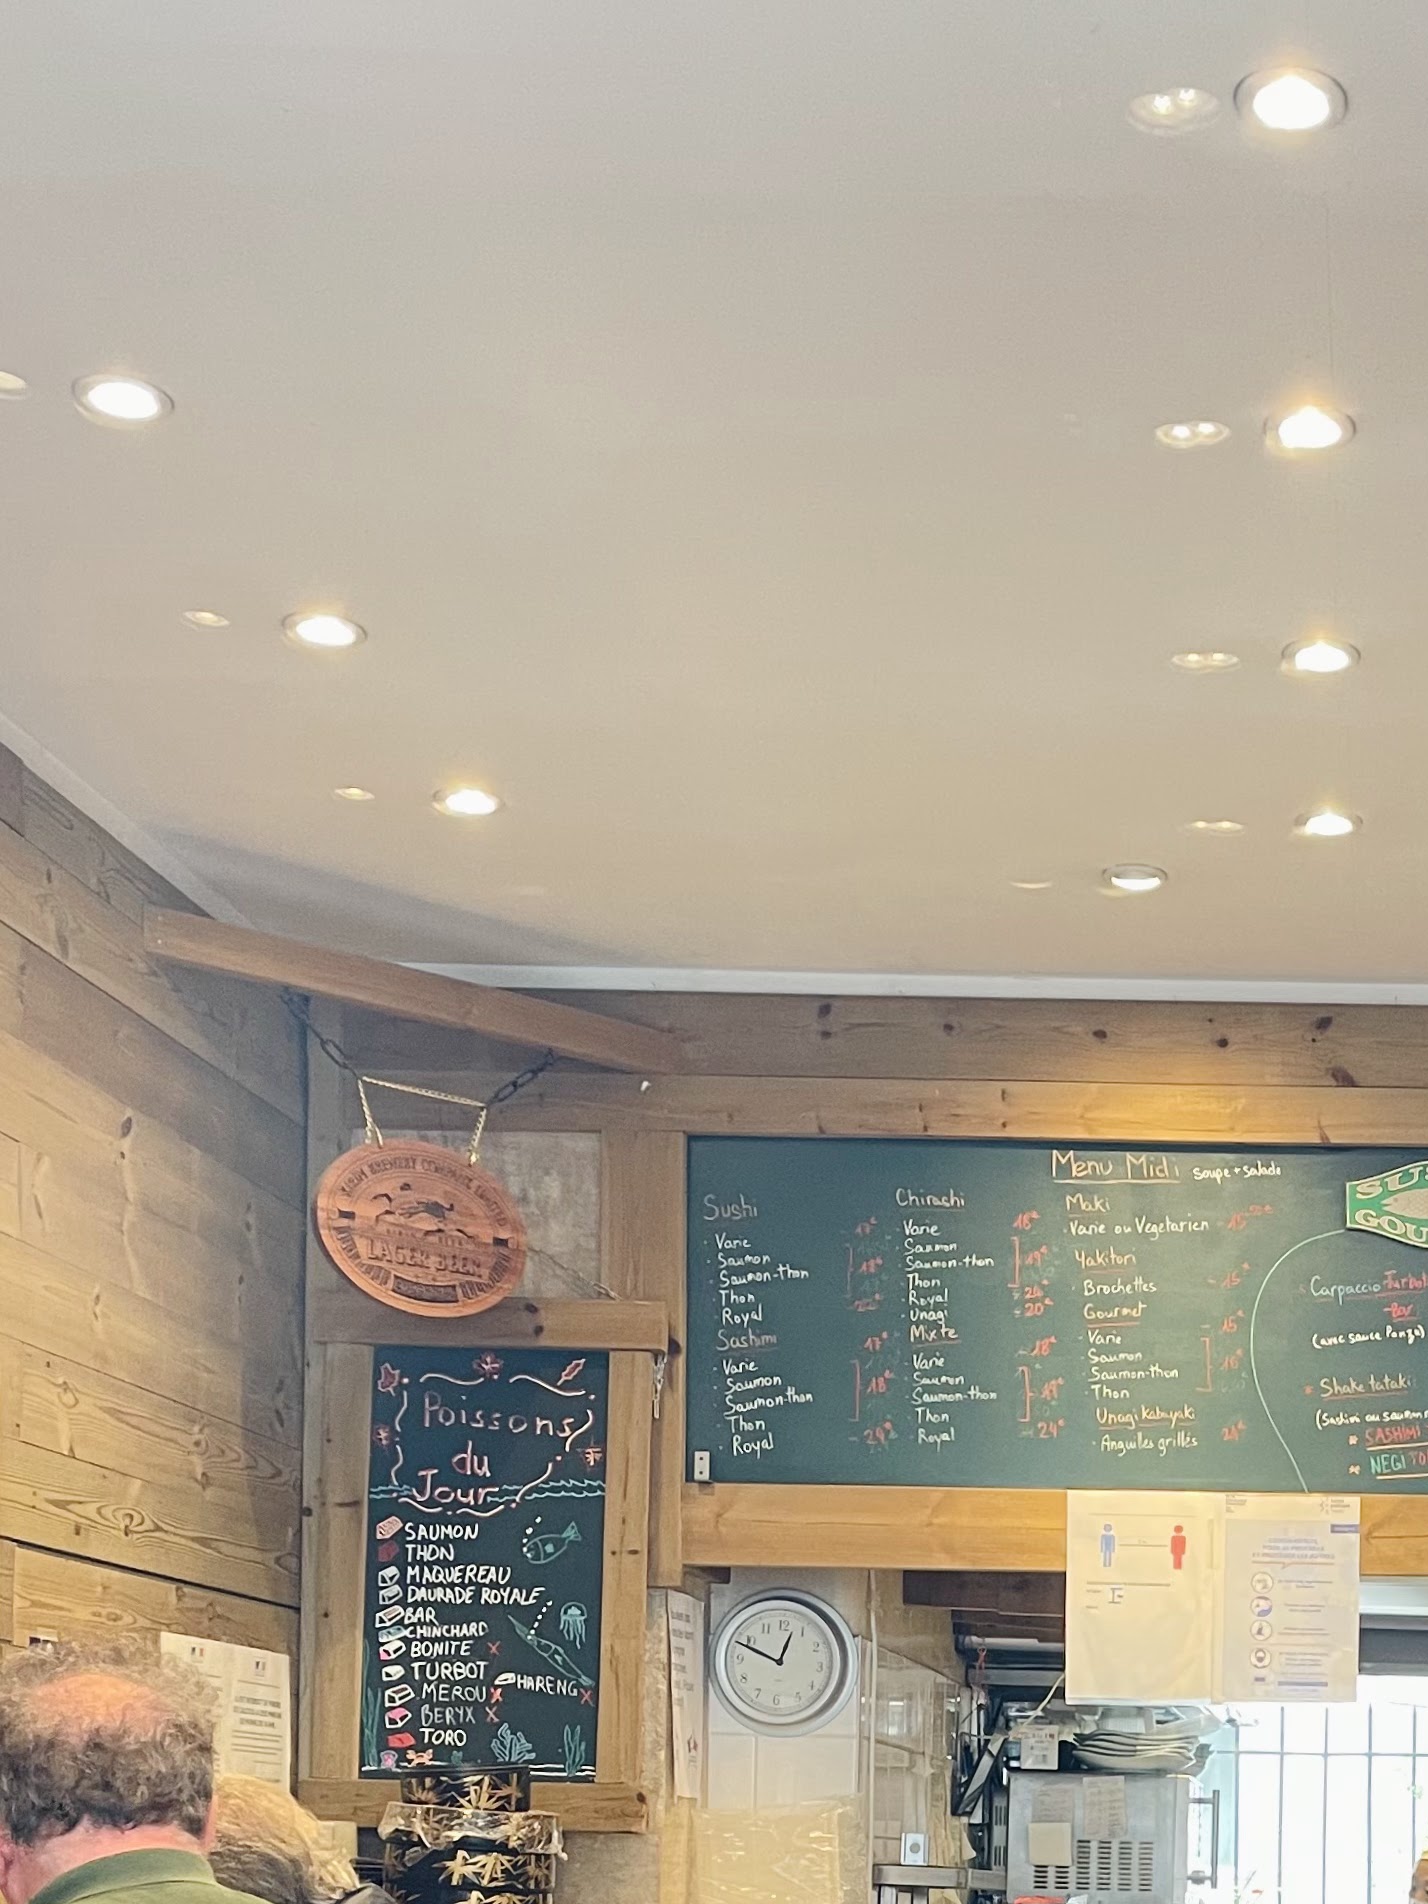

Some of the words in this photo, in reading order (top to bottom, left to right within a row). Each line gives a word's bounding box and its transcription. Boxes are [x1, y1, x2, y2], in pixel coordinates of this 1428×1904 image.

[1052, 1150, 1112, 1178] Menu
[1125, 1153, 1180, 1180] Midi
[703, 1193, 758, 1221] Sushi
[895, 1187, 966, 1209] Chirashi
[1066, 1193, 1111, 1214] Maki
[1075, 1246, 1136, 1269] Yakitori
[906, 1272, 942, 1291] Thon
[1083, 1277, 1159, 1297] Brochettes
[1310, 1275, 1382, 1306] Carpaccio
[719, 1289, 756, 1307] Thon
[908, 1287, 949, 1309] Royal
[722, 1302, 763, 1329] Royal
[910, 1308, 949, 1325] Unagi
[1084, 1301, 1148, 1320] Gourmet
[716, 1328, 778, 1351] Sashimi
[910, 1324, 959, 1343] Mixte
[1088, 1348, 1142, 1364] Saumon
[723, 1375, 782, 1395] Saumon
[1091, 1384, 1130, 1401] Thon
[1320, 1373, 1365, 1398] Shake
[423, 1391, 576, 1438] Poissons
[725, 1415, 766, 1434] Thon
[914, 1407, 950, 1424] Thon
[1096, 1407, 1139, 1430] Unagi
[732, 1431, 774, 1460] Royal
[918, 1427, 955, 1452] Royal
[451, 1440, 492, 1478] du
[411, 1468, 499, 1506] Jour
[404, 1522, 479, 1541] SAUMON
[405, 1543, 456, 1562] THON
[405, 1565, 513, 1585] MAQUEREAU
[406, 1585, 477, 1604] DAURADE
[480, 1586, 546, 1606] ROYALE
[403, 1606, 440, 1626] BAR
[404, 1621, 490, 1639] CHINCHARD
[409, 1640, 475, 1658] BONITE
[410, 1661, 489, 1682] TURBOT
[421, 1681, 488, 1704] MEROU
[516, 1674, 579, 1698] HARENG
[420, 1704, 477, 1728] BERYX
[418, 1728, 468, 1748] TORO
